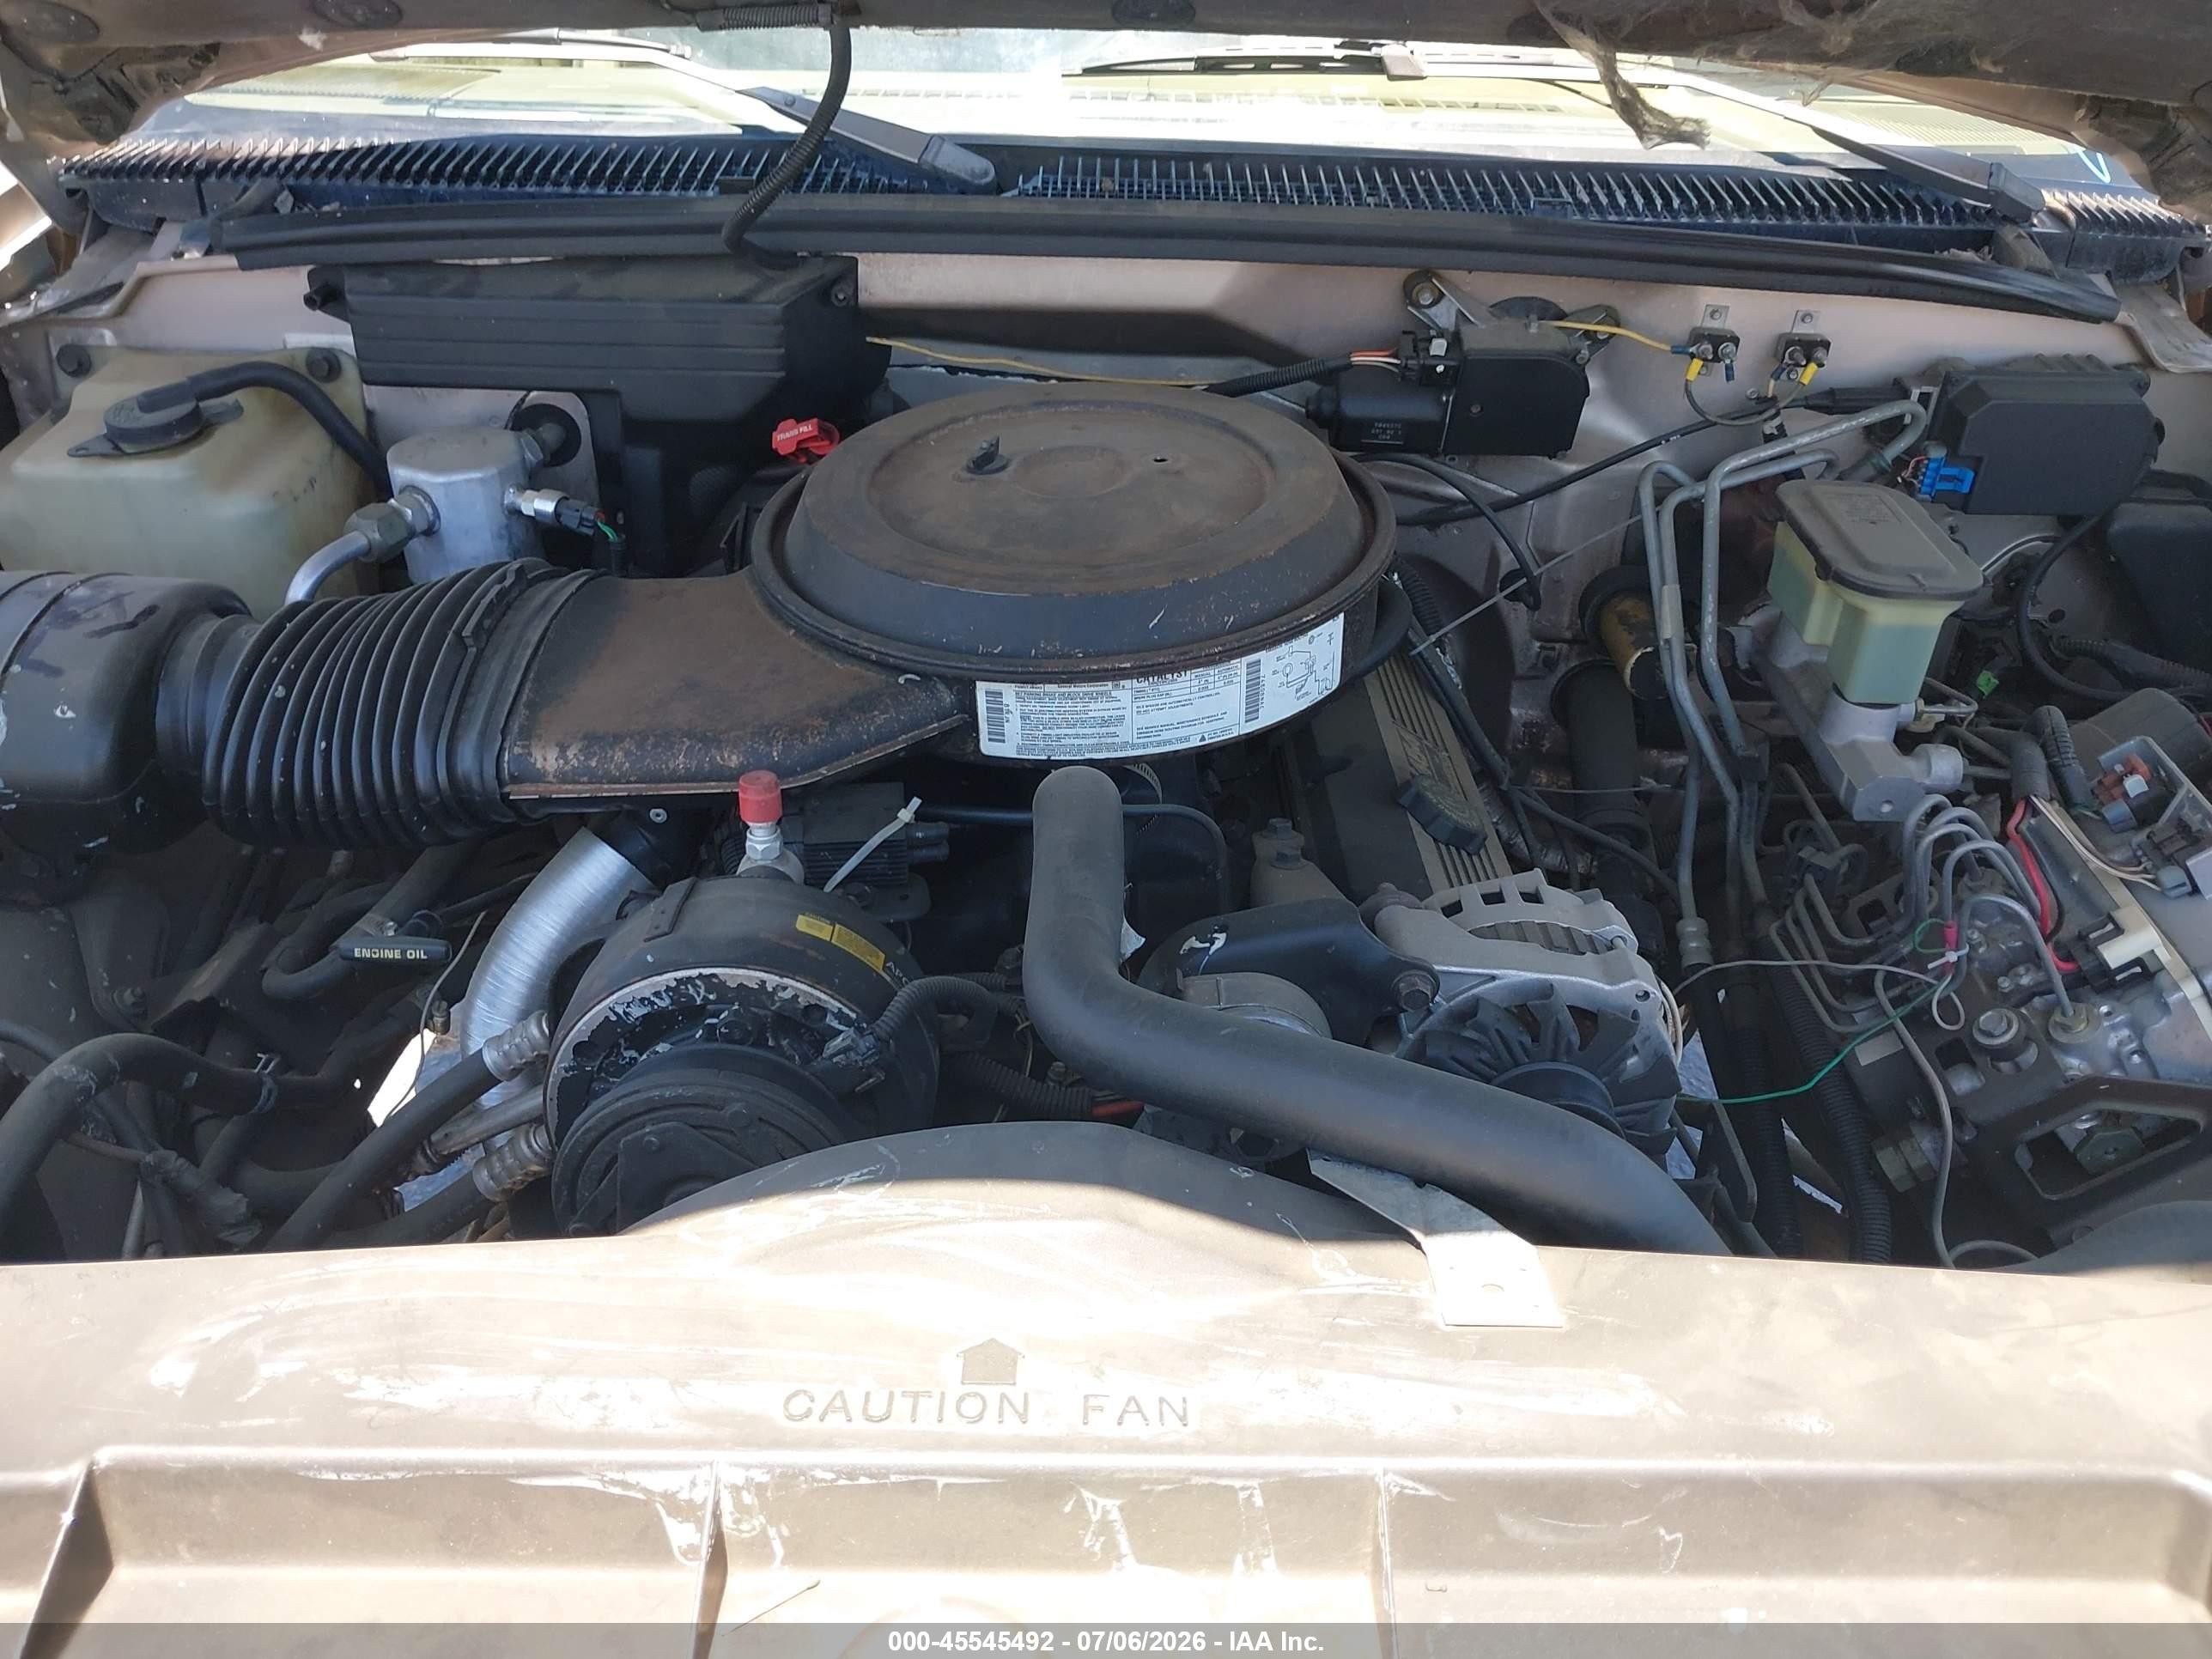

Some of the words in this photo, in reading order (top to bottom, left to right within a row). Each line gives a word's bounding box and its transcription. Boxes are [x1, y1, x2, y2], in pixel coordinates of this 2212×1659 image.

[354, 948, 402, 959] ENGINE
[406, 950, 428, 959] OIL
[783, 1389, 1030, 1423] CAUTION
[1082, 1394, 1188, 1426] FAN
